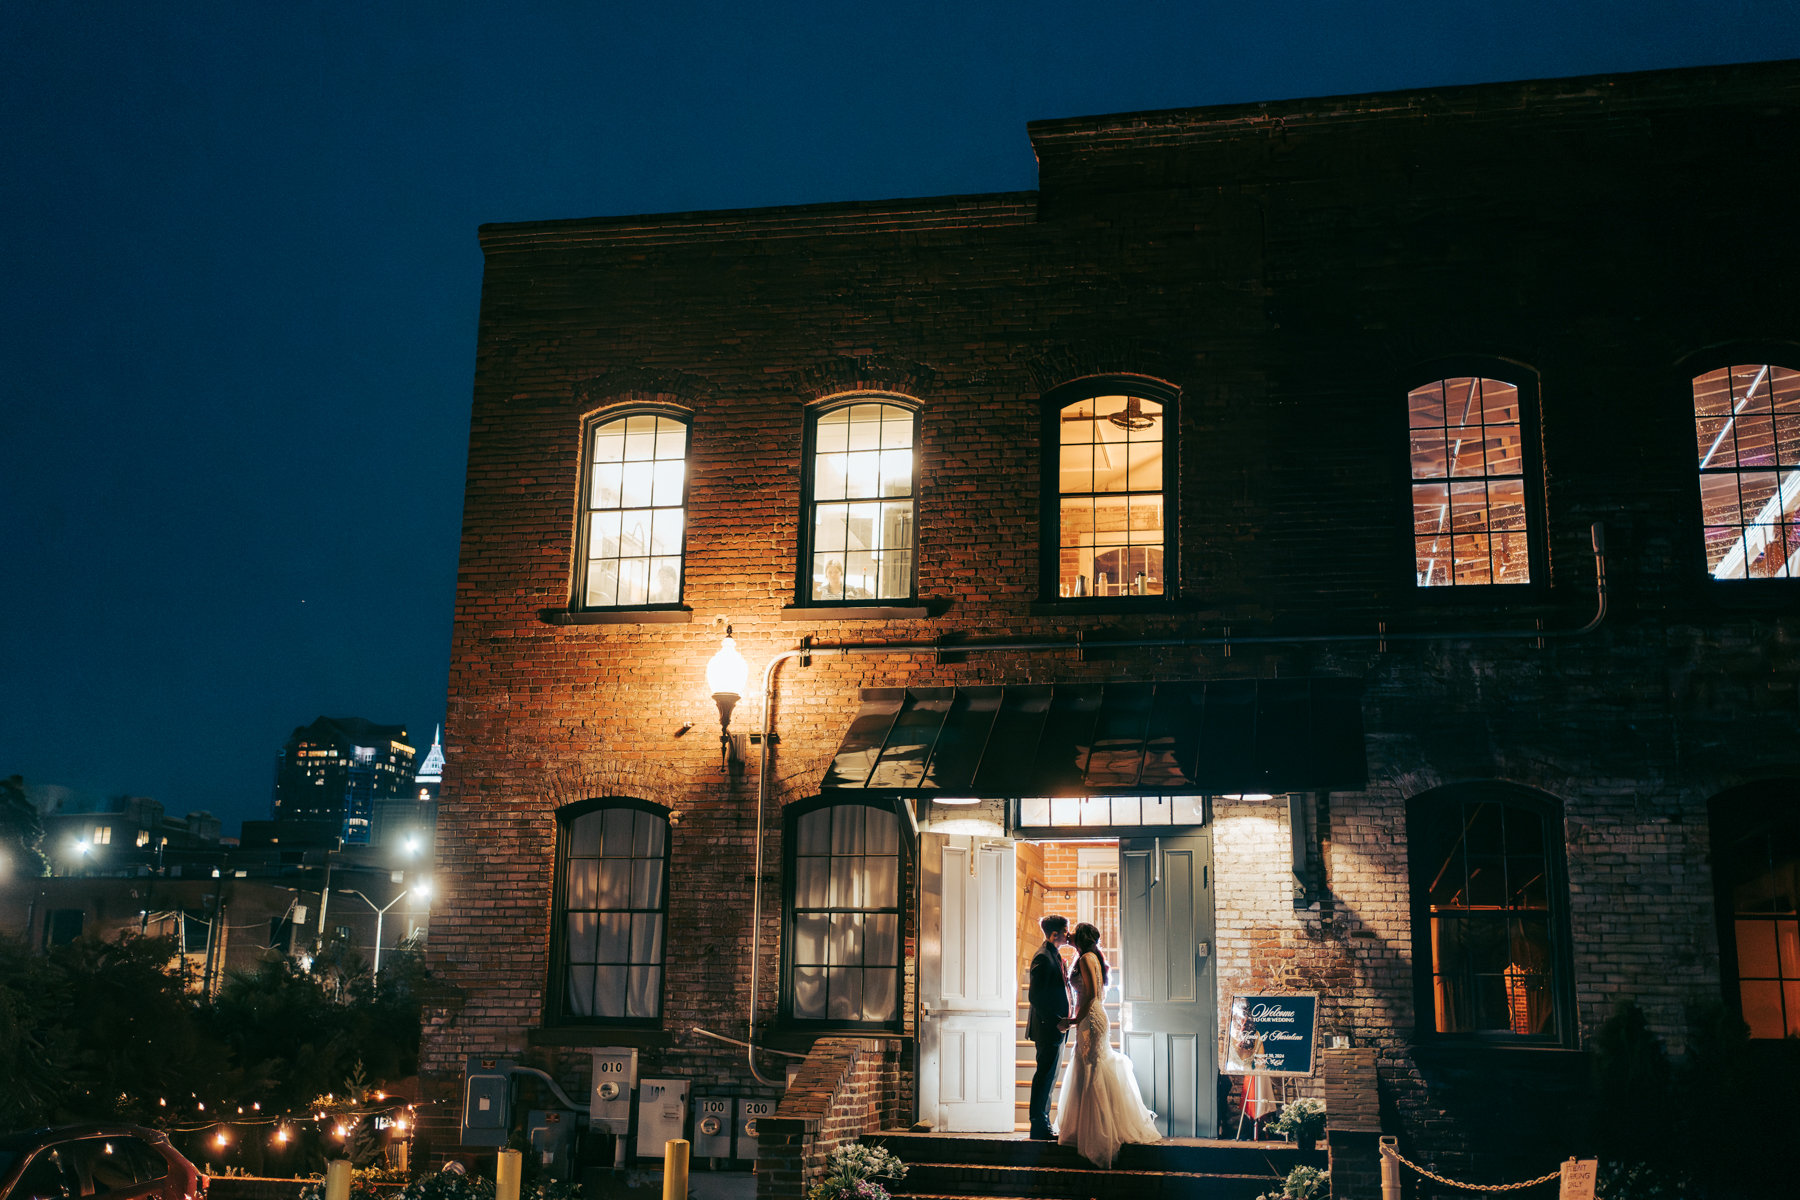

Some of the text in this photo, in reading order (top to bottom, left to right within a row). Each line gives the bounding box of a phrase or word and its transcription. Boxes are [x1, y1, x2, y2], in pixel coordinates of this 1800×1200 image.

[1251, 1003, 1295, 1018] Welcome
[602, 1062, 622, 1073] 010
[704, 1102, 724, 1112] 100
[746, 1103, 767, 1114] 200
